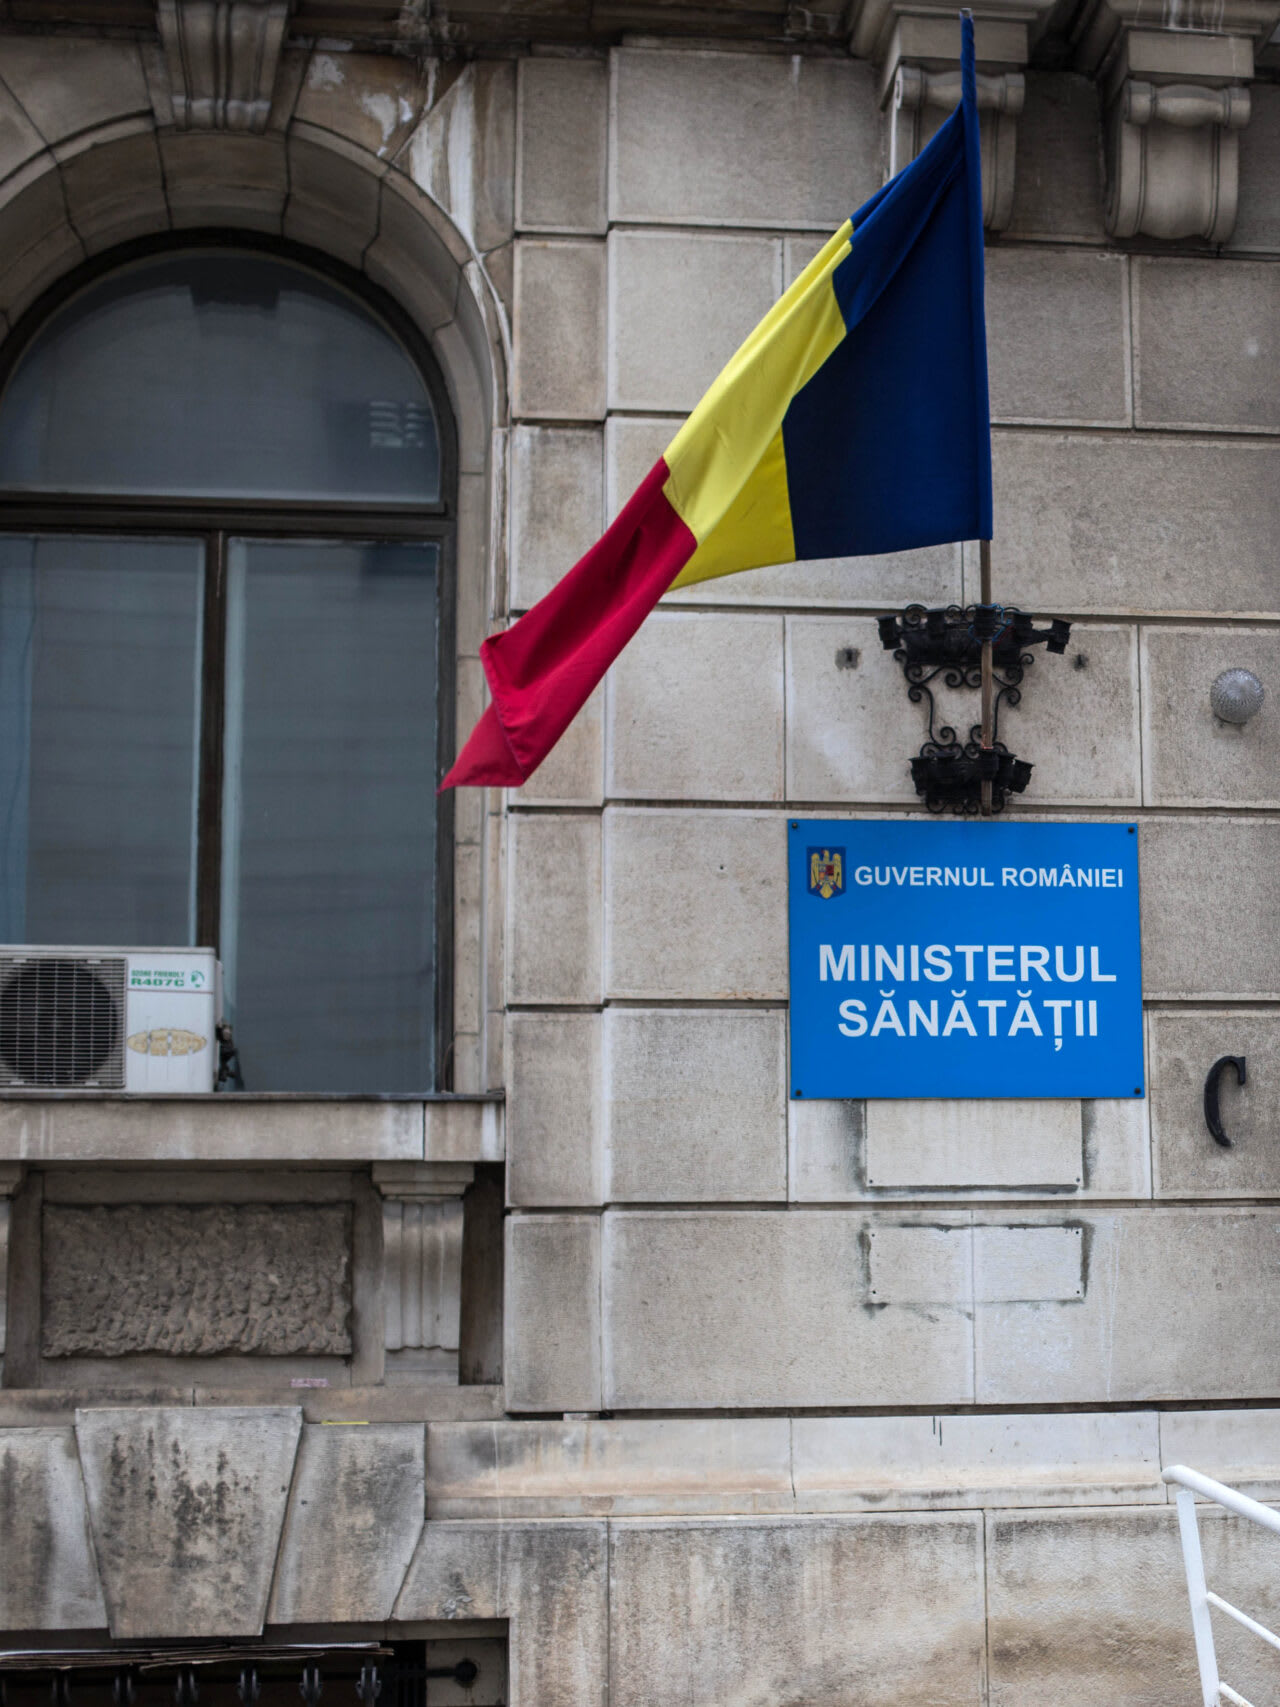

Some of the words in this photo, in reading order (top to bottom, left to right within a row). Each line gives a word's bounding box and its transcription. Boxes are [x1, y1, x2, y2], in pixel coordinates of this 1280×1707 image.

[854, 865, 995, 887] GUVERNUL
[1001, 864, 1124, 888] ROMÂNIEI
[819, 944, 1117, 983] MINISTERUL
[131, 977, 185, 987] R407C
